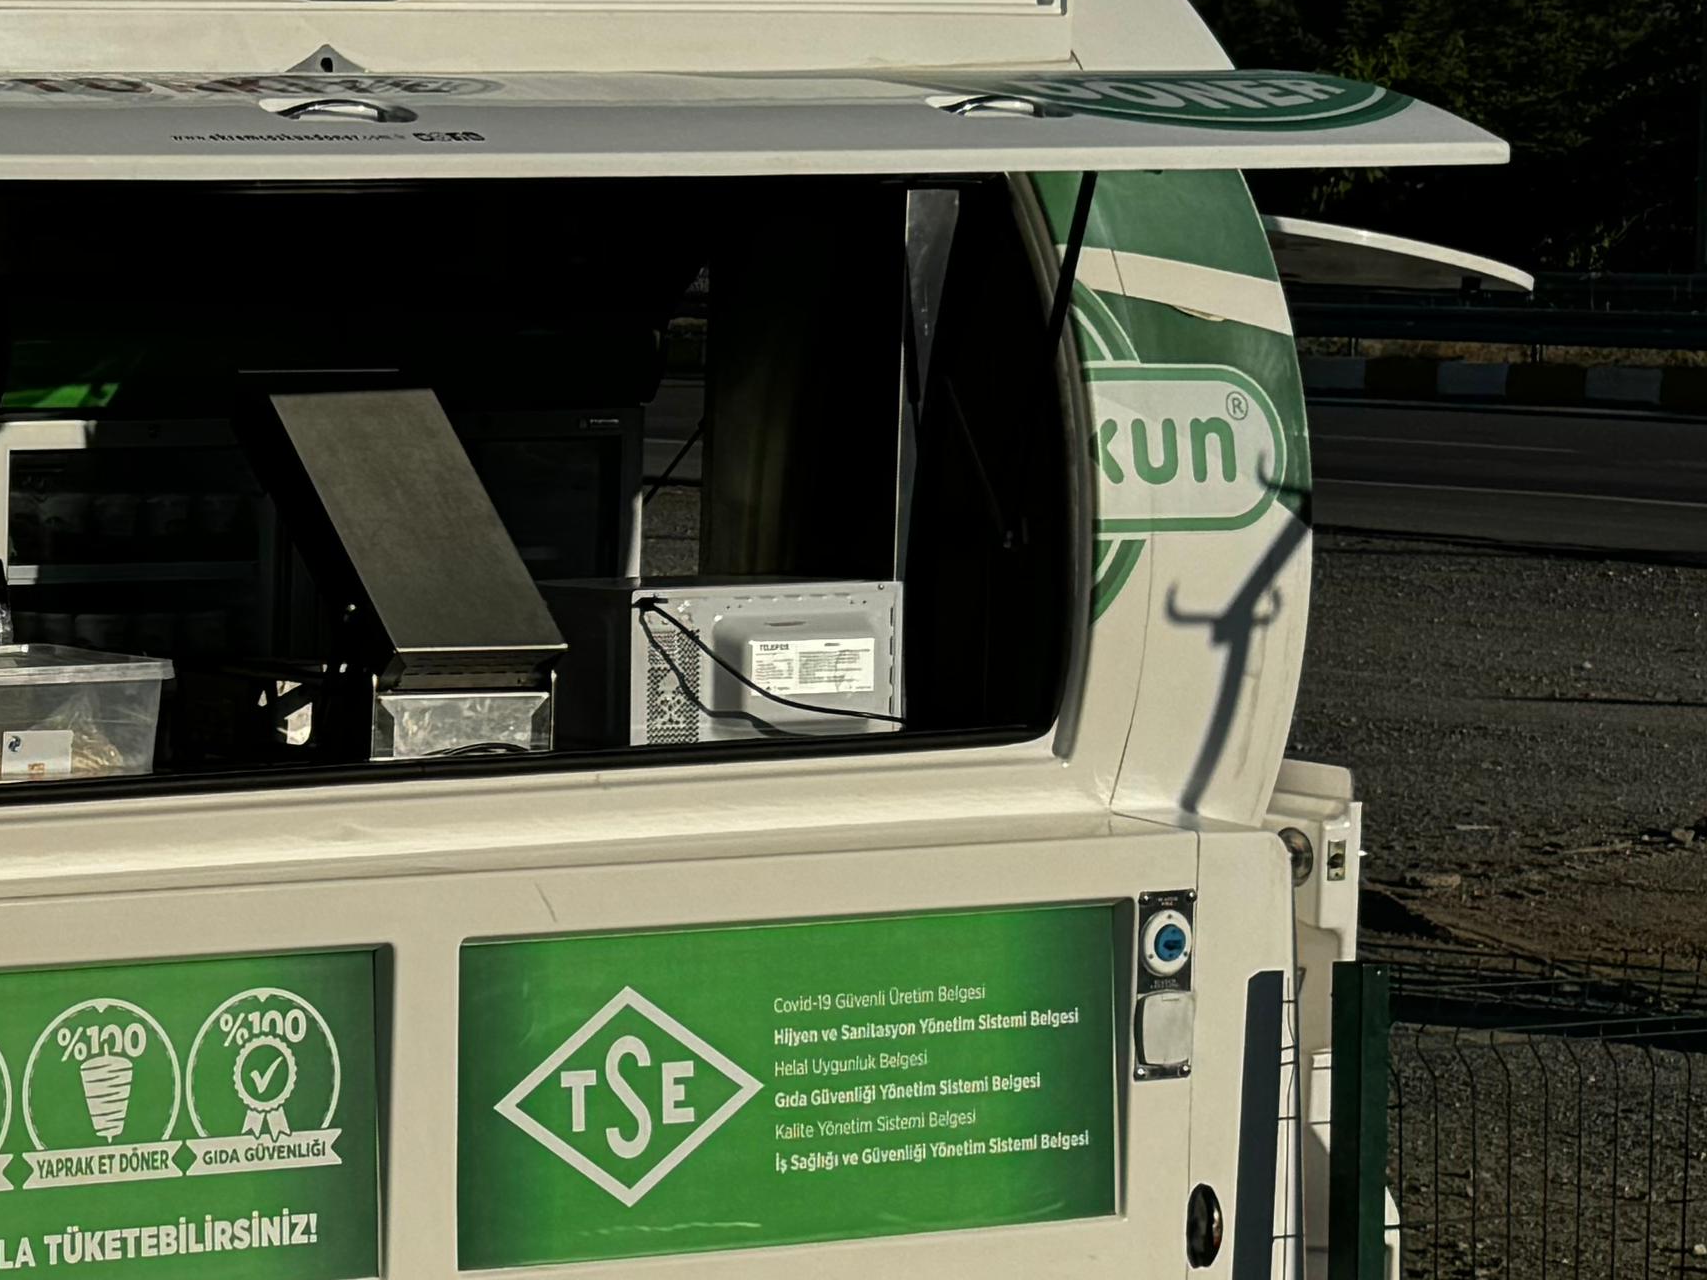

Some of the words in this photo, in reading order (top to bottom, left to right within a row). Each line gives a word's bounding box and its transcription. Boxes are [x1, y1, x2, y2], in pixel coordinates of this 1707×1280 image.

[774, 995, 832, 1014] Covid-19
[836, 989, 886, 1009] Güvenli
[889, 986, 934, 1006] Üretim
[938, 983, 986, 1004] Belgesi
[56, 1022, 147, 1062] %100
[219, 1008, 308, 1048] %100
[774, 1027, 818, 1047] Hijyen
[821, 1028, 838, 1041] ve
[841, 1021, 916, 1042] Sanitasyon
[919, 1016, 976, 1035] Yönetim
[978, 1012, 1027, 1030] Sistemi
[1030, 1007, 1079, 1027] Belgesi
[774, 1059, 809, 1077] Helal
[812, 1054, 876, 1076] Uygunluk
[879, 1048, 928, 1071] Belgesi
[560, 1035, 695, 1159] TSE
[774, 1089, 808, 1108] Gıda
[810, 1083, 876, 1106] Güvenliği
[879, 1081, 936, 1100] Yönetim
[939, 1076, 989, 1095] Sistemi
[992, 1071, 1041, 1092] Belgesi
[775, 1121, 814, 1140] Kalite
[817, 1117, 873, 1137] Yönetim
[876, 1113, 925, 1132] Sistemi
[929, 1107, 977, 1128] Belgesi
[36, 1154, 95, 1181] YAPRAK
[98, 1154, 115, 1175] ET
[119, 1146, 170, 1173] DÖNER
[202, 1147, 241, 1166] GIDA
[775, 1152, 788, 1174] İş
[790, 1150, 838, 1172] Sağlığı
[842, 1152, 858, 1166] ve
[862, 1146, 927, 1167] Güvenliği
[930, 1139, 986, 1158] Yönetim
[989, 1134, 1038, 1154] Sistemi
[1041, 1129, 1090, 1150] Belgesi
[43, 1207, 320, 1266] TÜKETEBİLİRSİNİZ!
